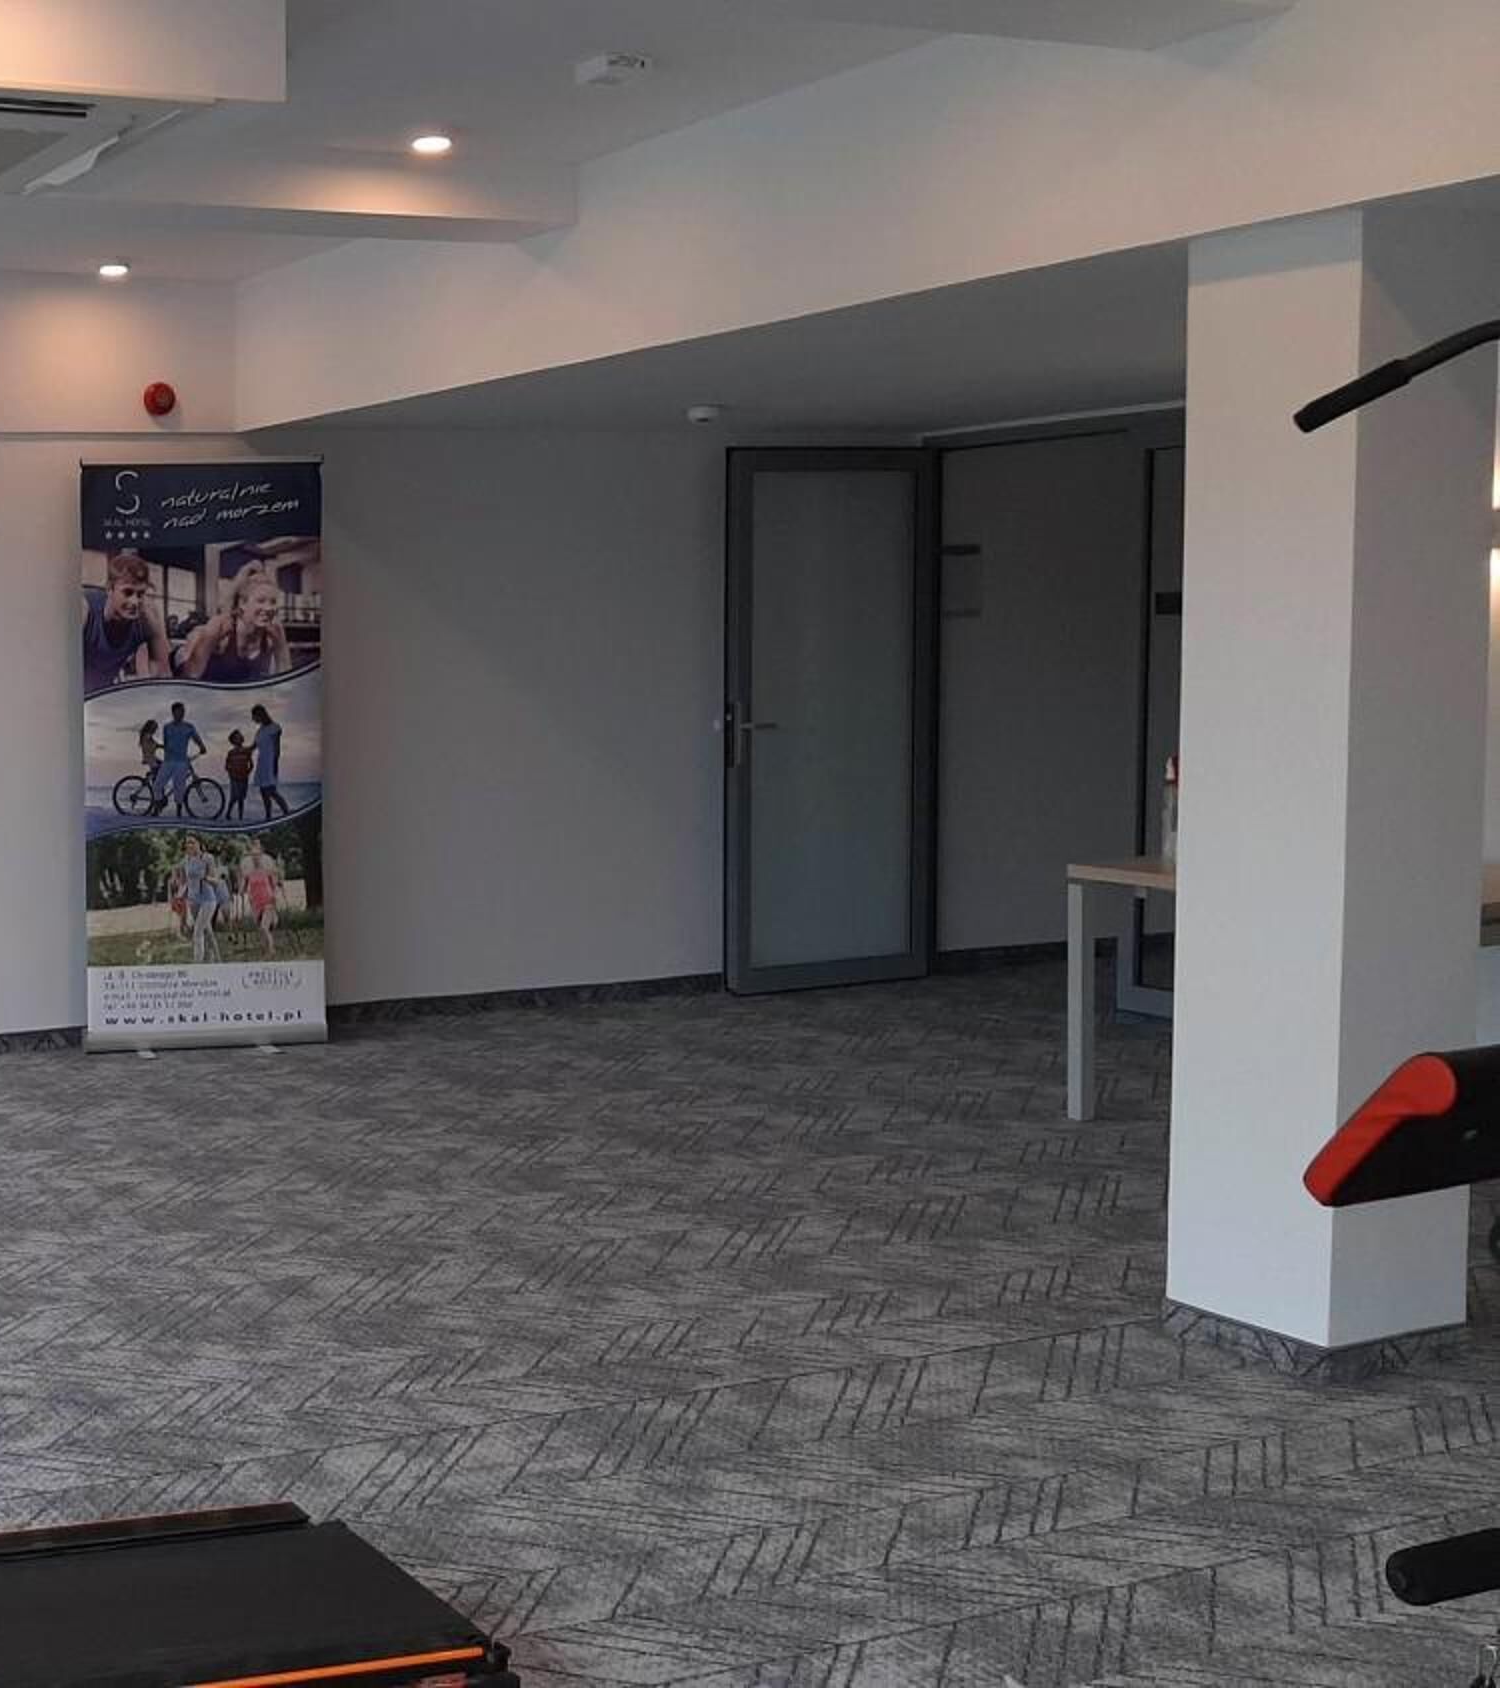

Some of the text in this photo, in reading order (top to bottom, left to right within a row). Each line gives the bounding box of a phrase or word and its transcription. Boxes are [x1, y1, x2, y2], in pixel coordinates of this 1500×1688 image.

[160, 481, 275, 509] naturalnie
[163, 507, 206, 529] nad
[215, 498, 300, 522] morzem
[104, 1010, 303, 1026] www.skal-hotel.pl
